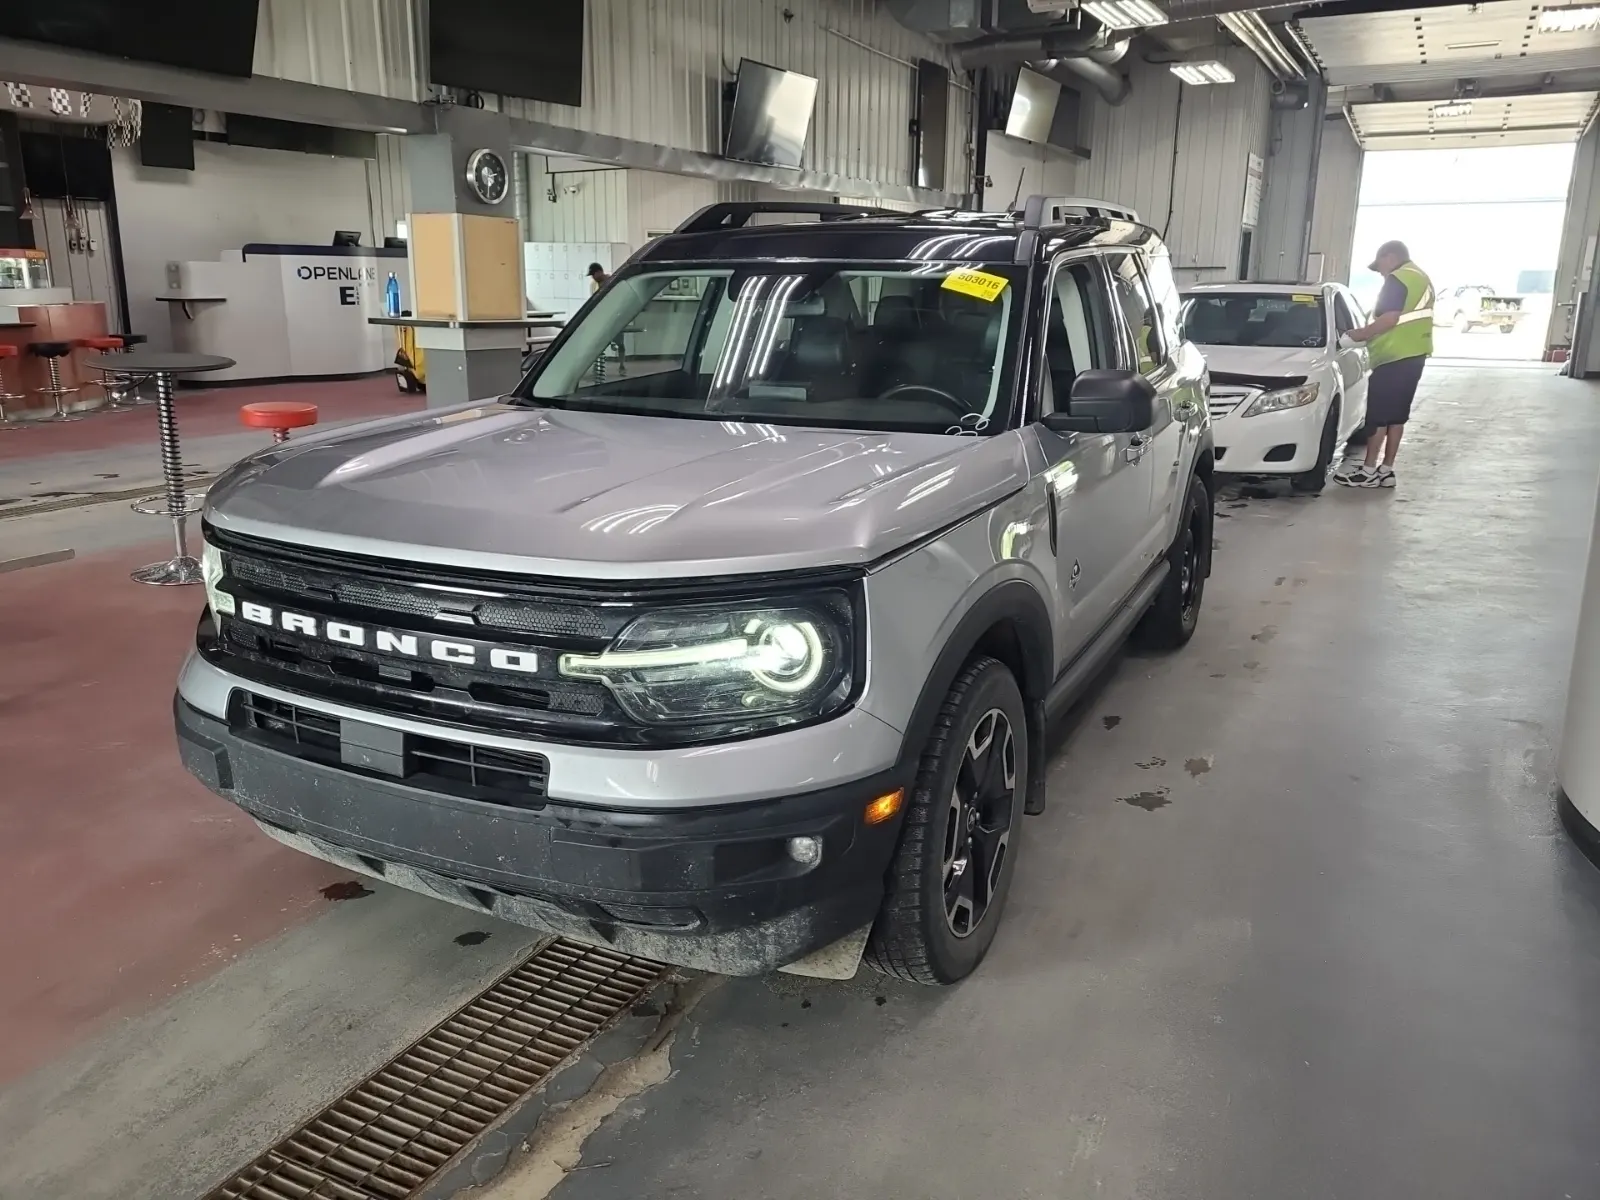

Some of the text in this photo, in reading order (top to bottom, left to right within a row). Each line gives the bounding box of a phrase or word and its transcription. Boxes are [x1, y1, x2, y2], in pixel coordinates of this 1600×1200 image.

[958, 273, 1000, 290] 503016
[339, 286, 356, 306] E
[241, 600, 539, 673] BRONCO
